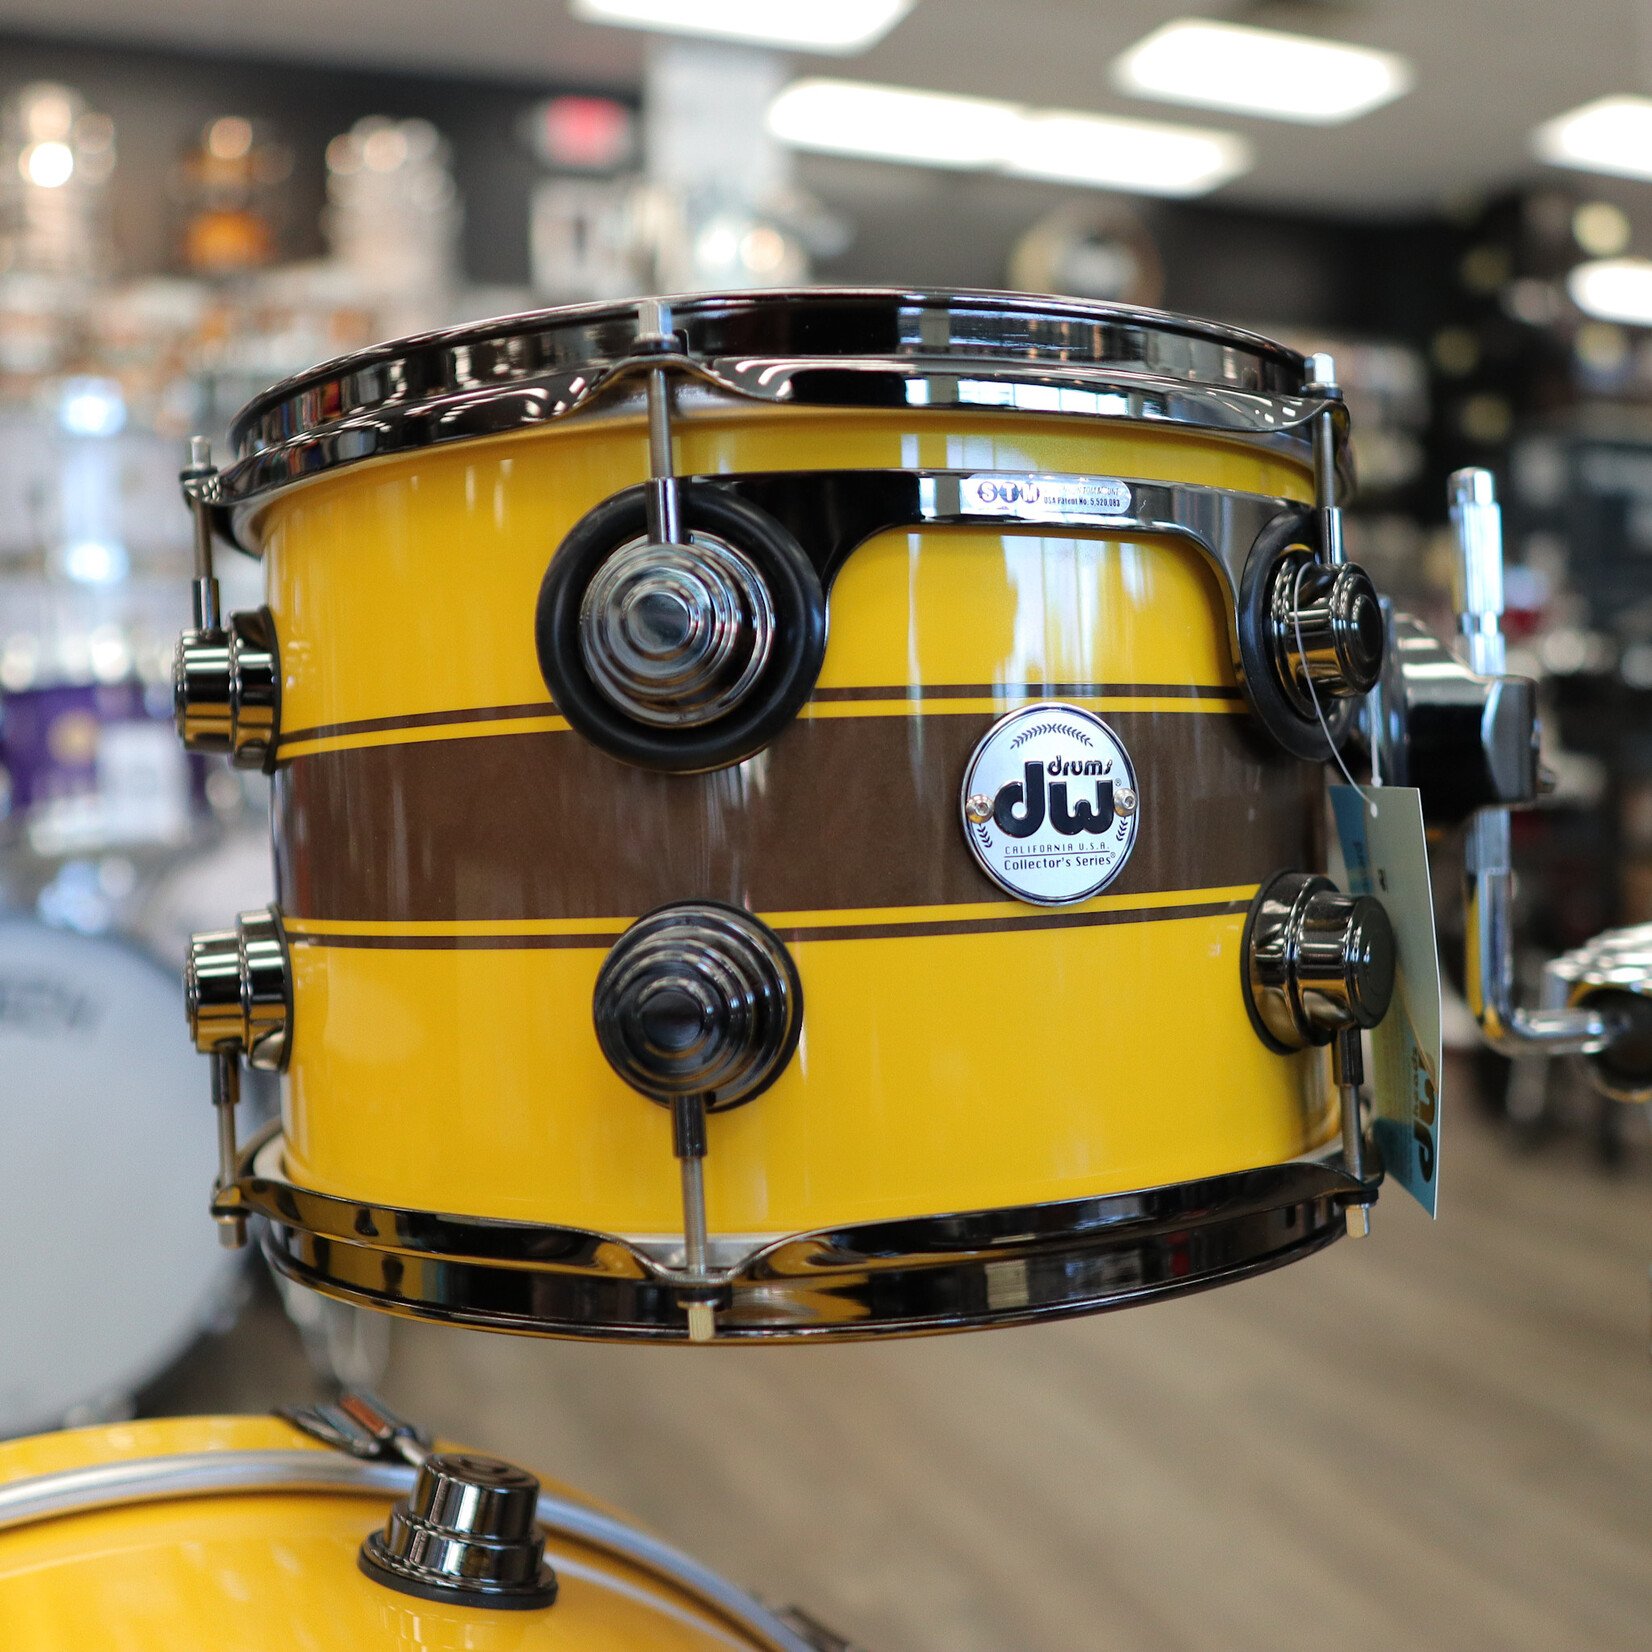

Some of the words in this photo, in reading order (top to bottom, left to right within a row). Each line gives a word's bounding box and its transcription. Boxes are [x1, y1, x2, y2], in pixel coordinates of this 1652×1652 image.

[977, 481, 1040, 504] STM
[1044, 497, 1056, 505] USA
[1057, 497, 1078, 506] Patent
[1079, 497, 1090, 506] No.
[1047, 755, 1112, 776] drums
[993, 760, 1114, 839] dw
[1004, 842, 1073, 855] CALIFORNIA
[1079, 841, 1110, 851] U.S.A.
[1004, 857, 1072, 871] Collector's
